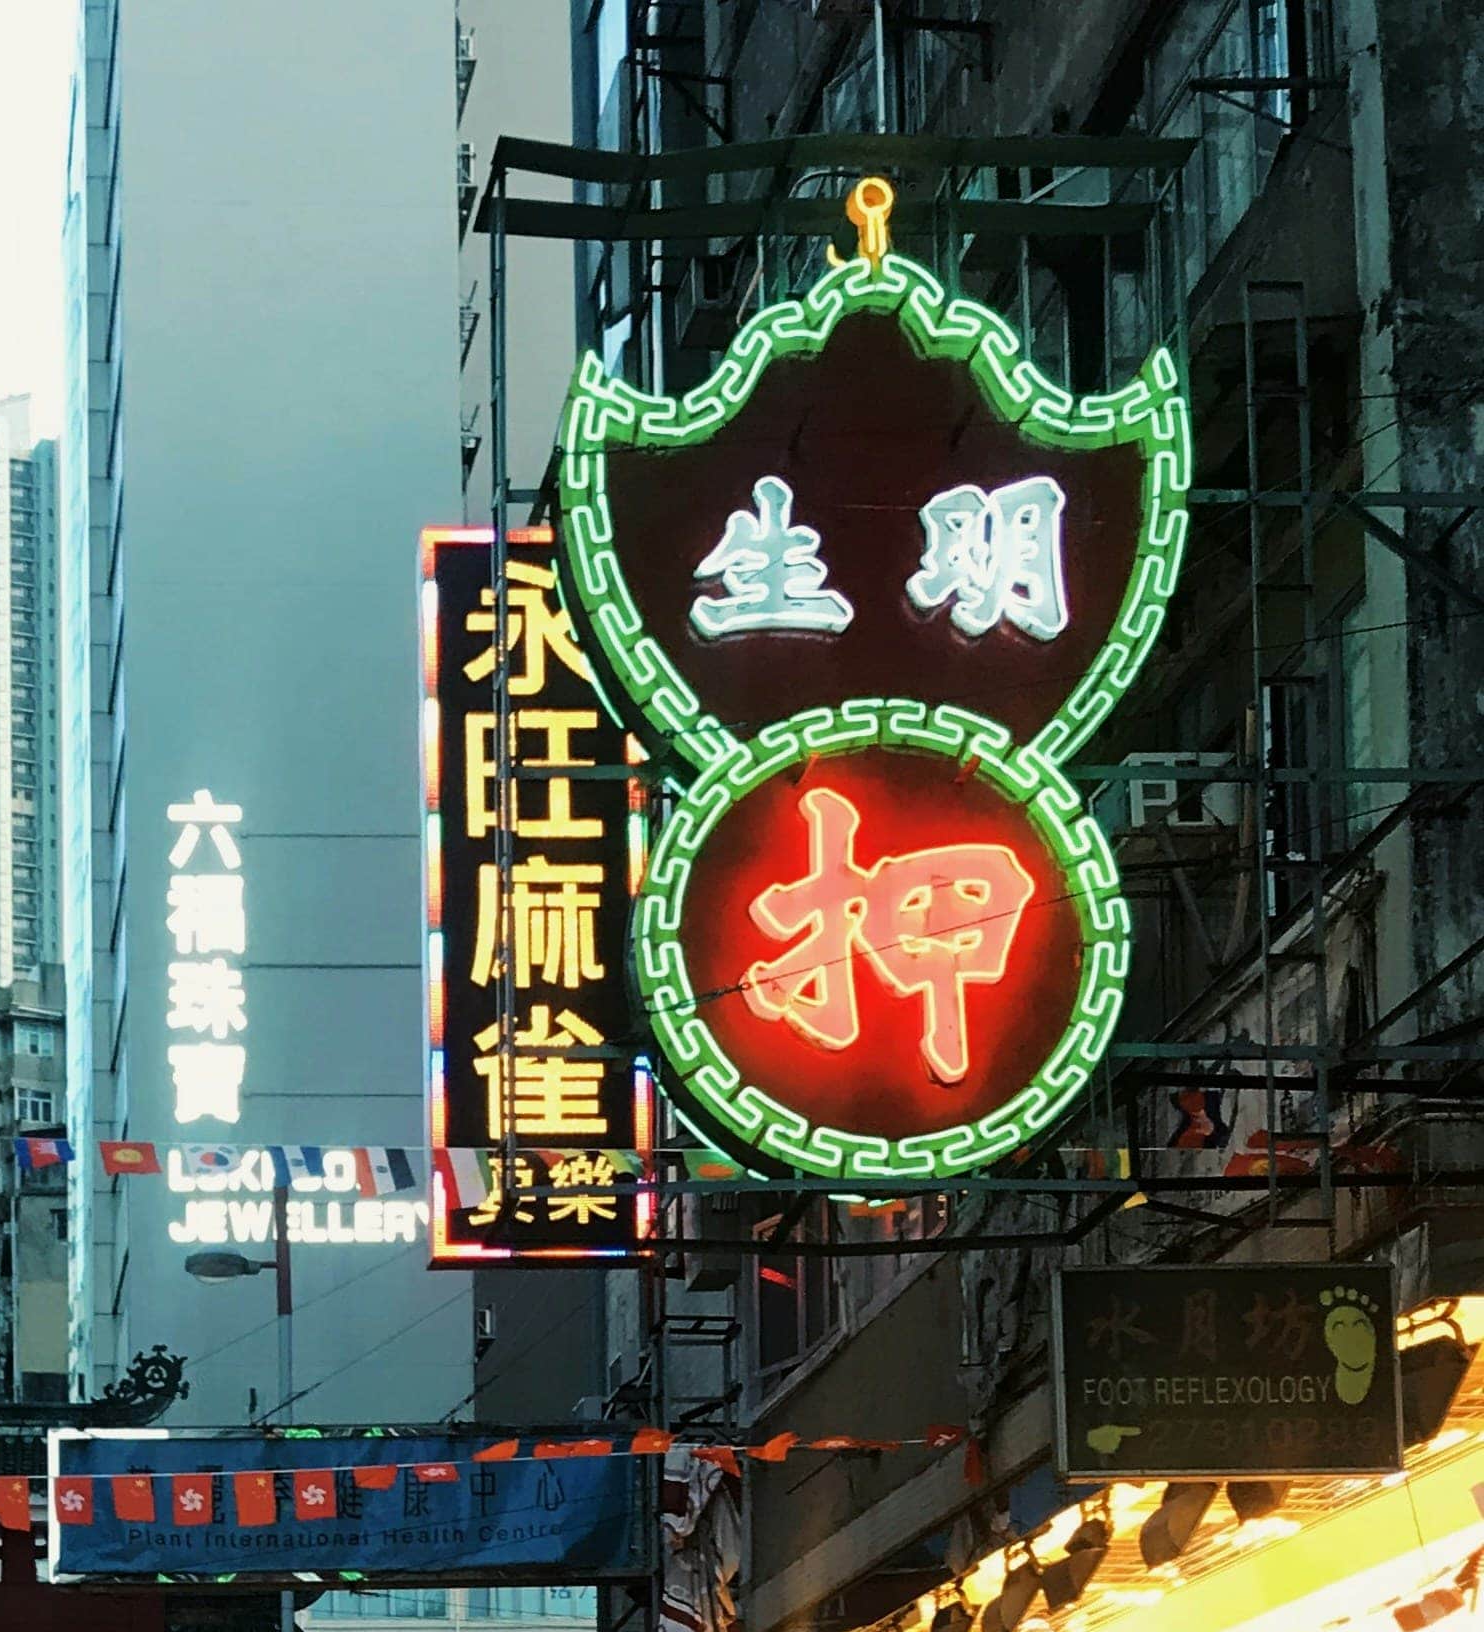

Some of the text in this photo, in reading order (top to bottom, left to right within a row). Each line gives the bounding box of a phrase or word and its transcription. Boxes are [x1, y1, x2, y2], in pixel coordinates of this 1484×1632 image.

[462, 561, 607, 1138] 永旺麻雀
[746, 787, 1034, 1086] 押
[1084, 1375, 1331, 1405] FOOT REFLEXOLOGY
[128, 1519, 563, 1548] Plant International Health Centre
